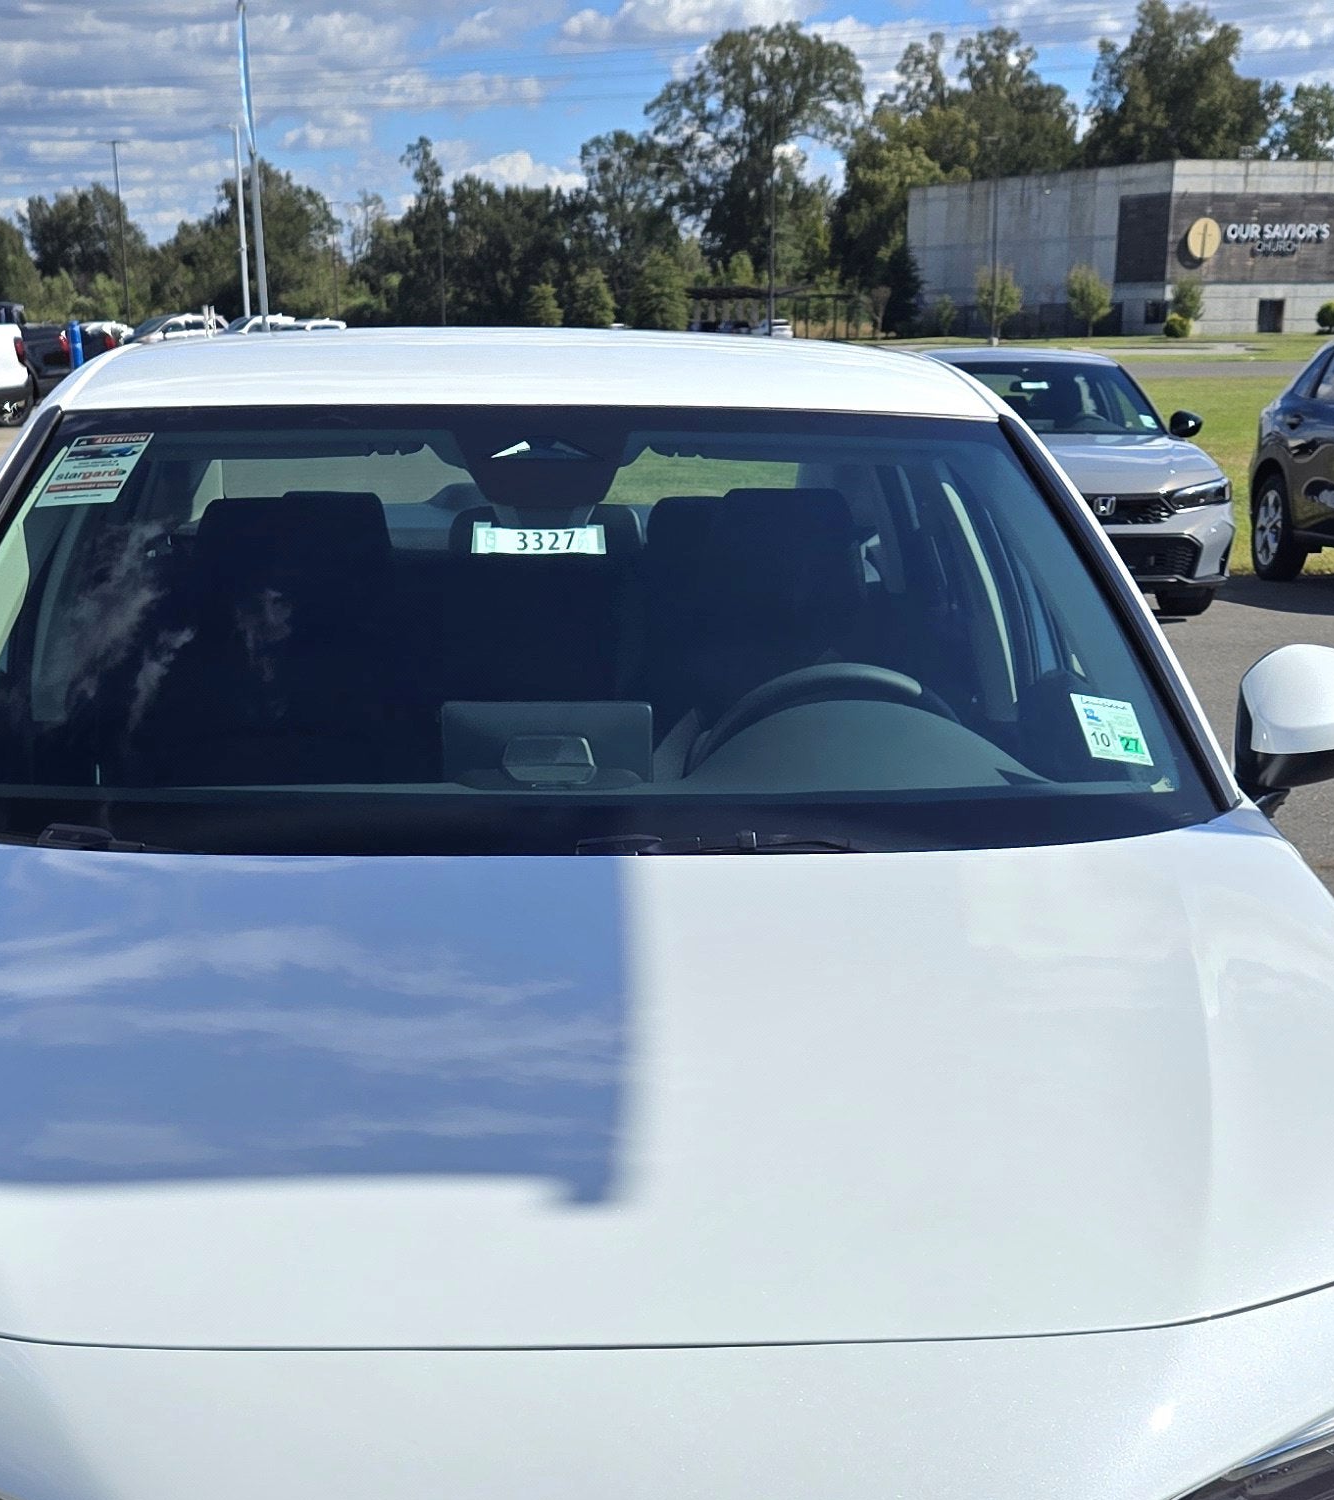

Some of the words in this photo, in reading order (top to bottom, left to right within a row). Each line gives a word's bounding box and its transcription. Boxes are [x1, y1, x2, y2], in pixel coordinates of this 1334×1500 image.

[1226, 223, 1261, 239] OUR
[1263, 223, 1331, 239] SAVIOR'S
[95, 434, 147, 443] ATTENTION
[516, 529, 576, 551] 3327
[1090, 730, 1111, 748] 10
[1119, 736, 1140, 752] 27
